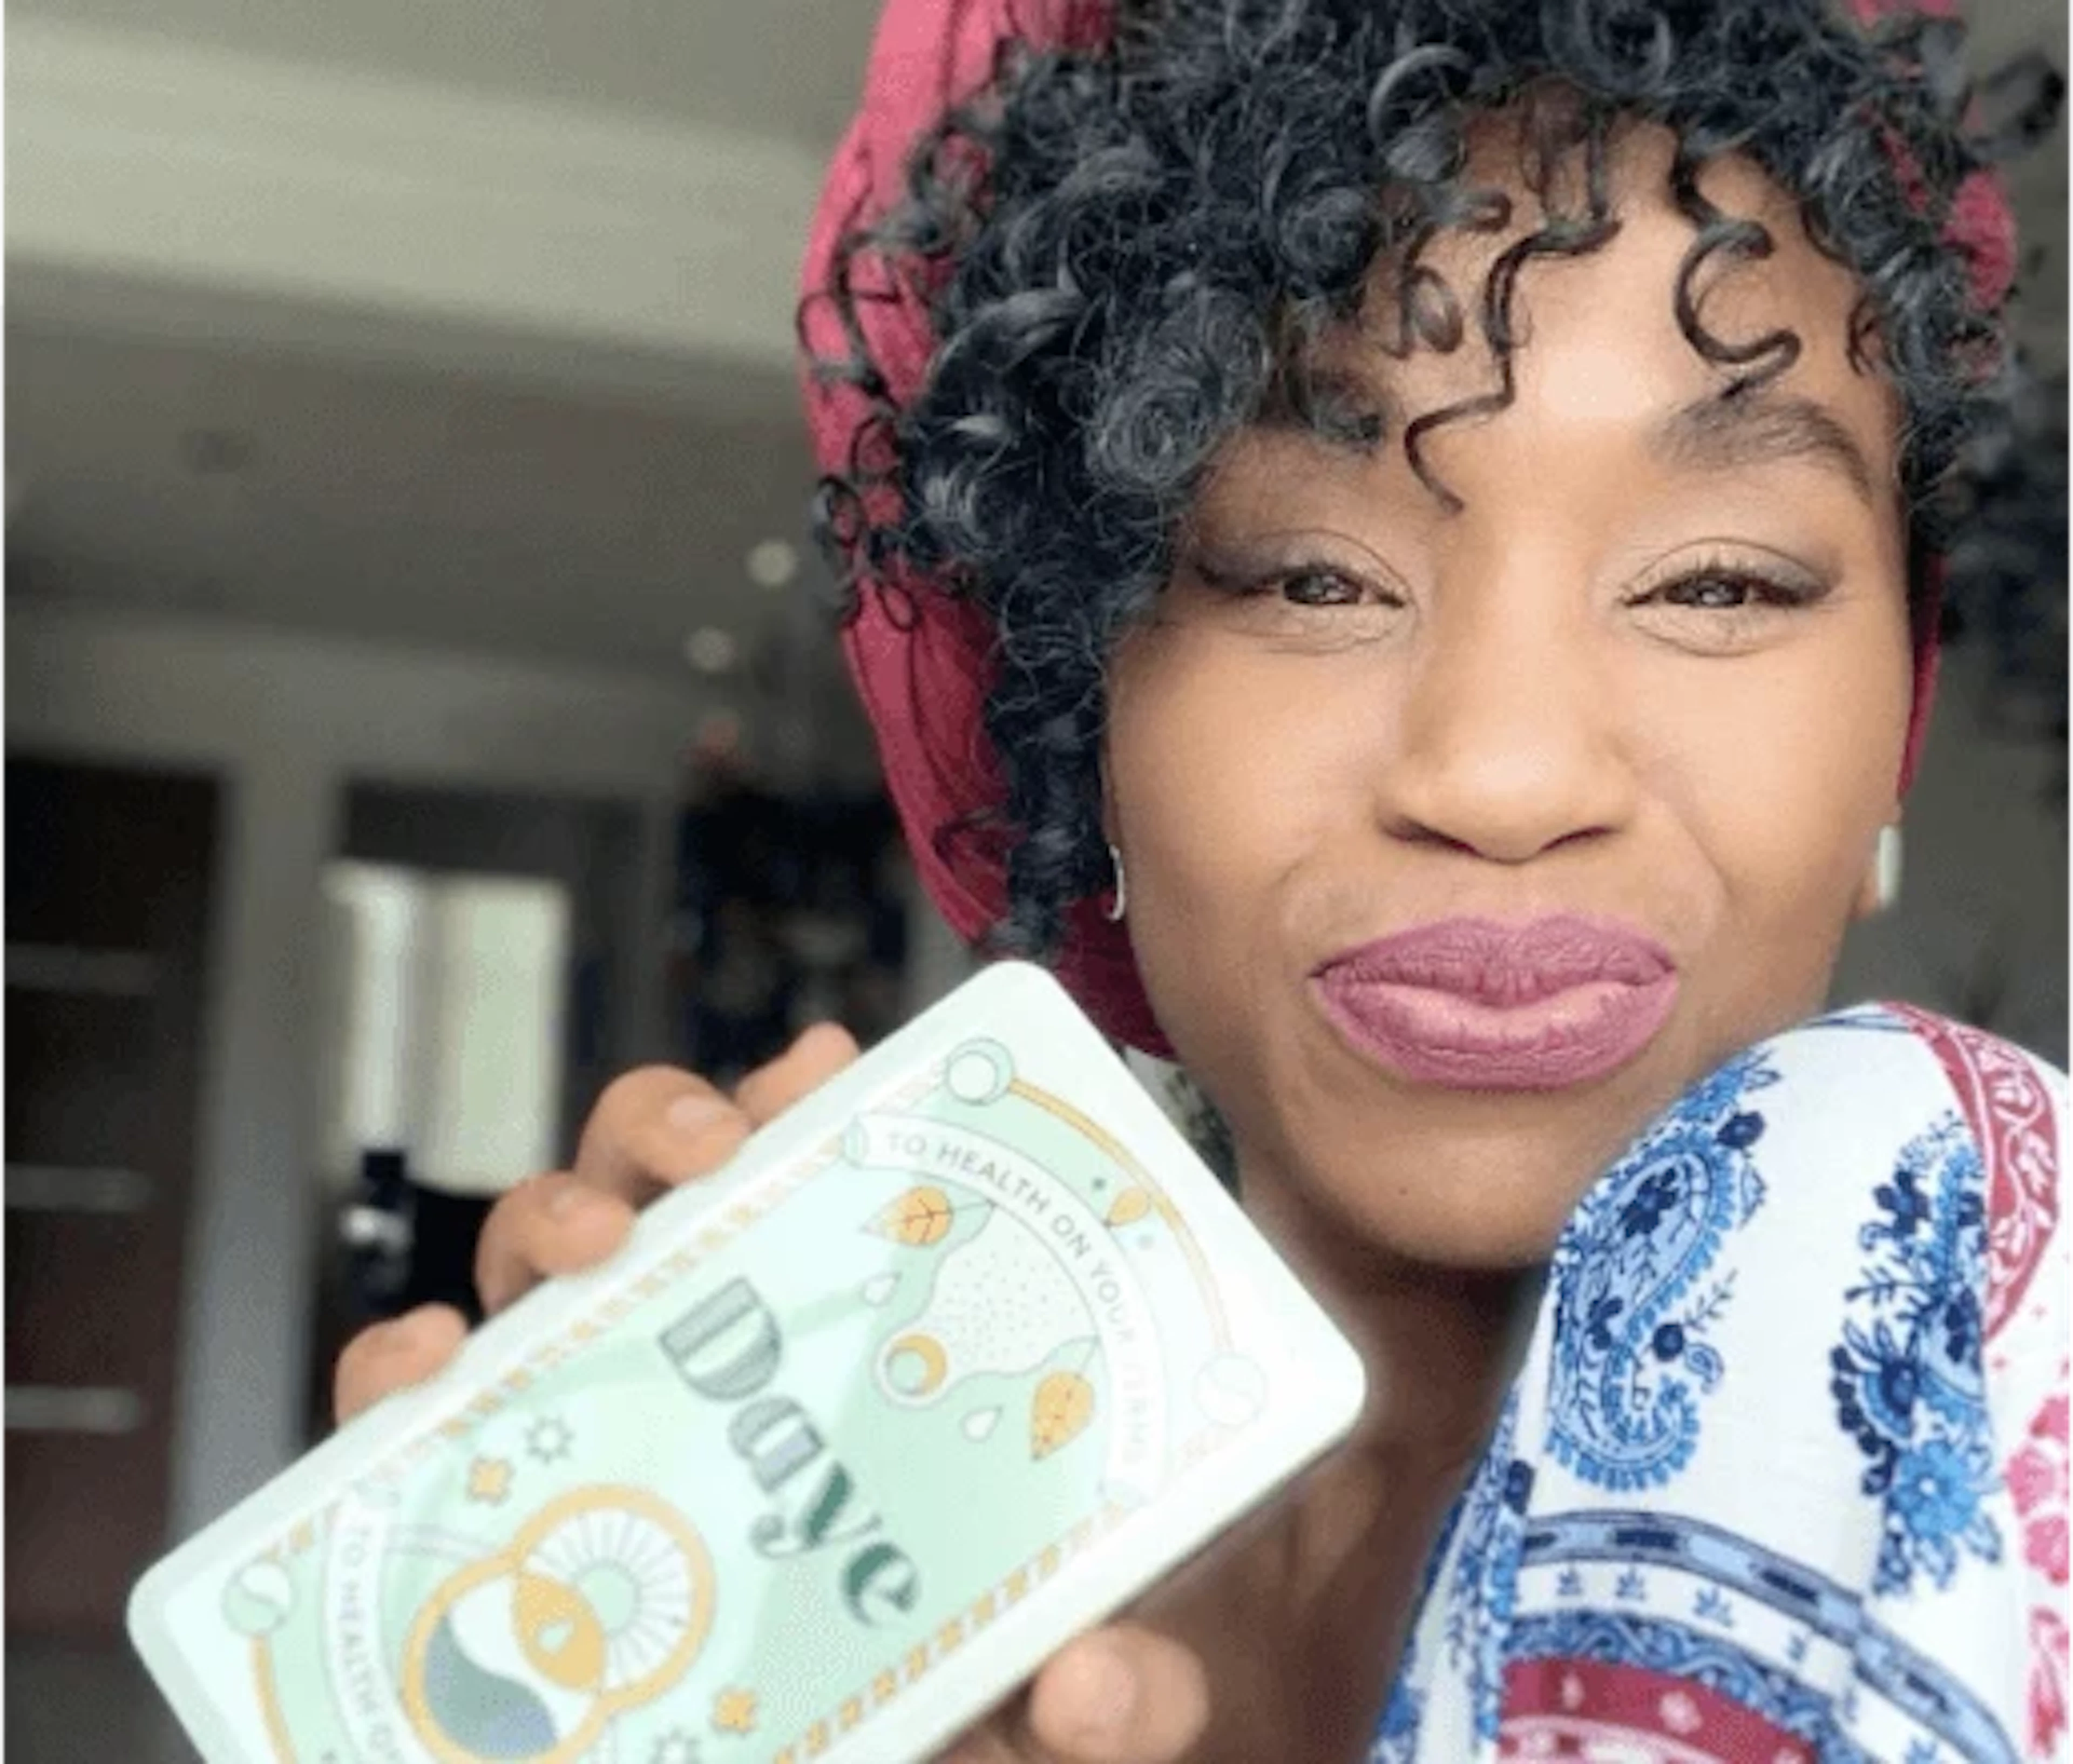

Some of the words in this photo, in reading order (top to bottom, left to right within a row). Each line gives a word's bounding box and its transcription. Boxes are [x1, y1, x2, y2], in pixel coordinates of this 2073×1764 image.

[885, 1131, 928, 1157] TO
[937, 1141, 1052, 1215] HEALTH
[1049, 1213, 1093, 1261] ON
[657, 1275, 920, 1626] Daye
